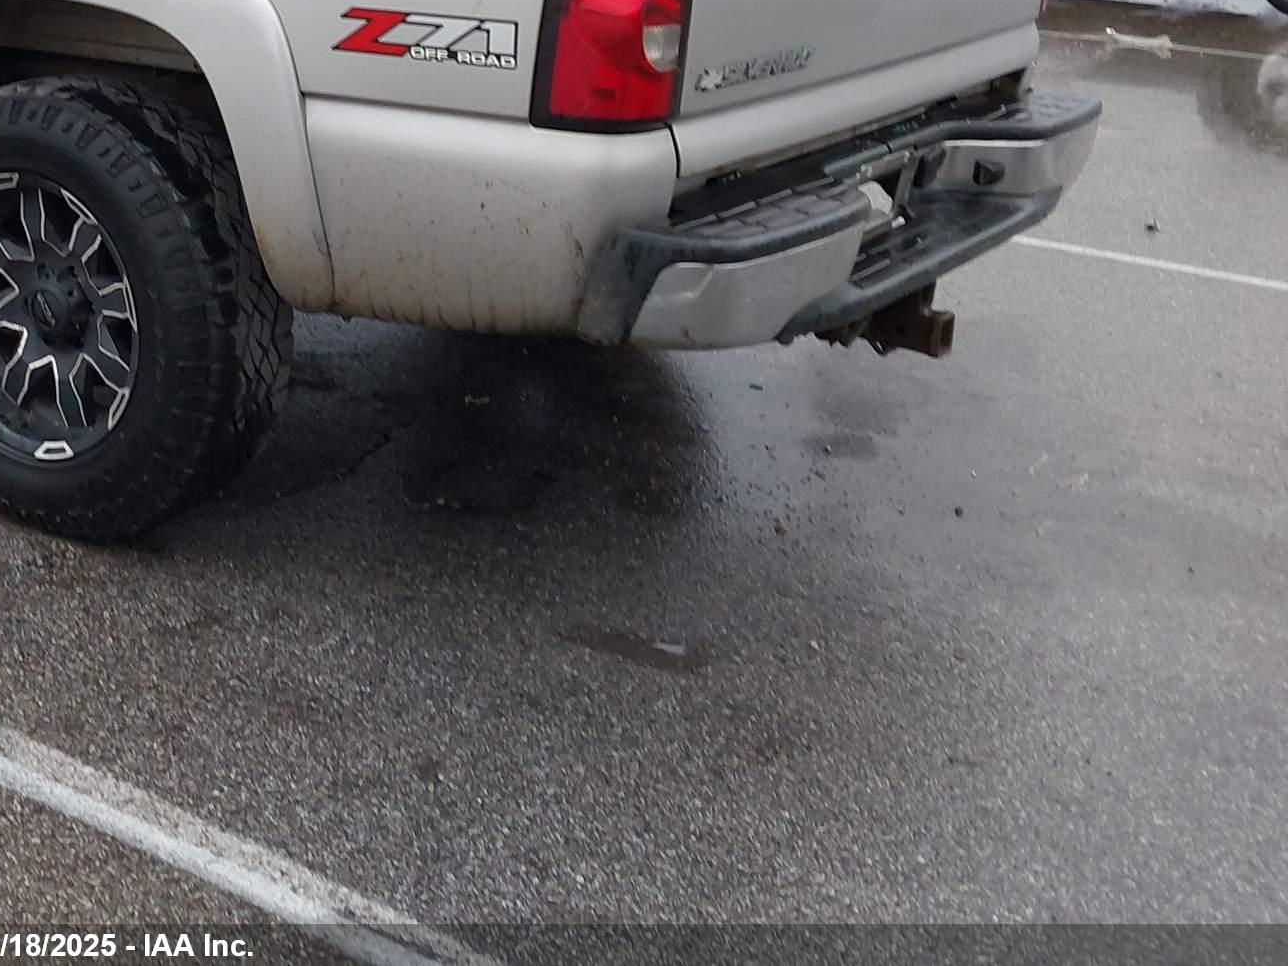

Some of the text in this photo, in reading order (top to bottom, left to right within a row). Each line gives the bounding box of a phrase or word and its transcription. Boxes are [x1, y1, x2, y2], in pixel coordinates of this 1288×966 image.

[331, 7, 518, 57] Z71
[409, 45, 517, 70] OFF ROAD
